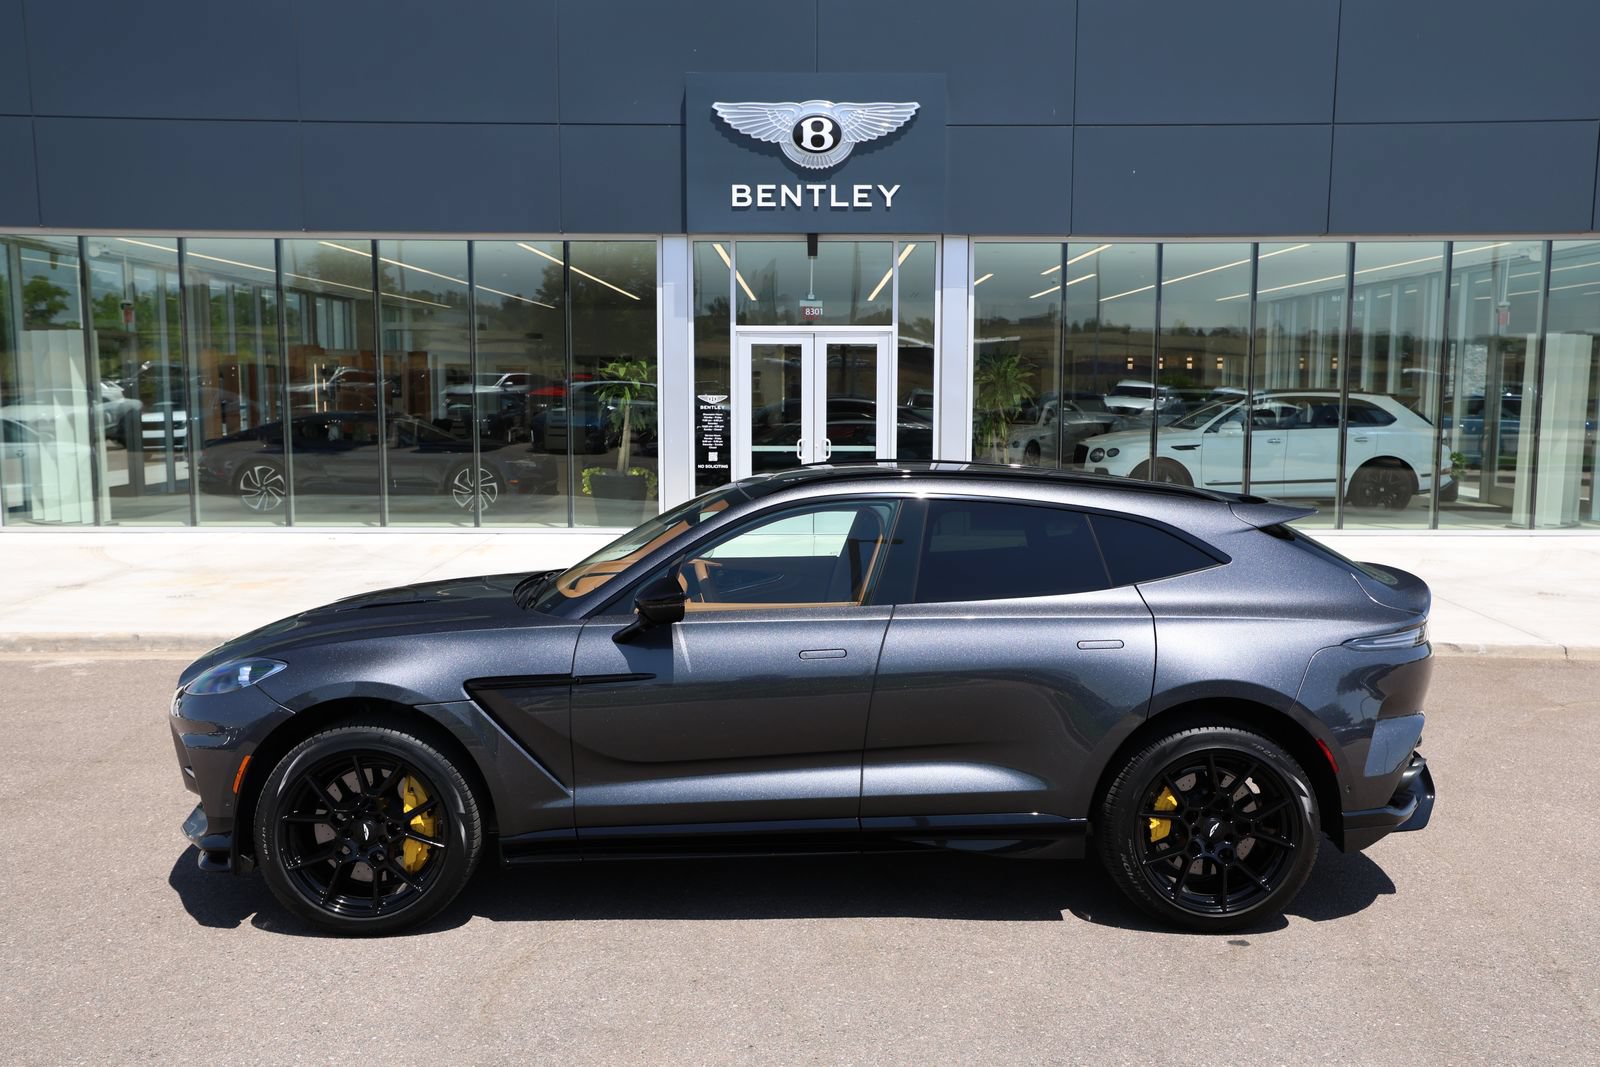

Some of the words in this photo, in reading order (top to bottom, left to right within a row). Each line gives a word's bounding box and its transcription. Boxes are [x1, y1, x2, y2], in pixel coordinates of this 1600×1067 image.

[800, 116, 834, 151] B
[731, 184, 901, 208] BENTLEY
[805, 307, 823, 316] 8301
